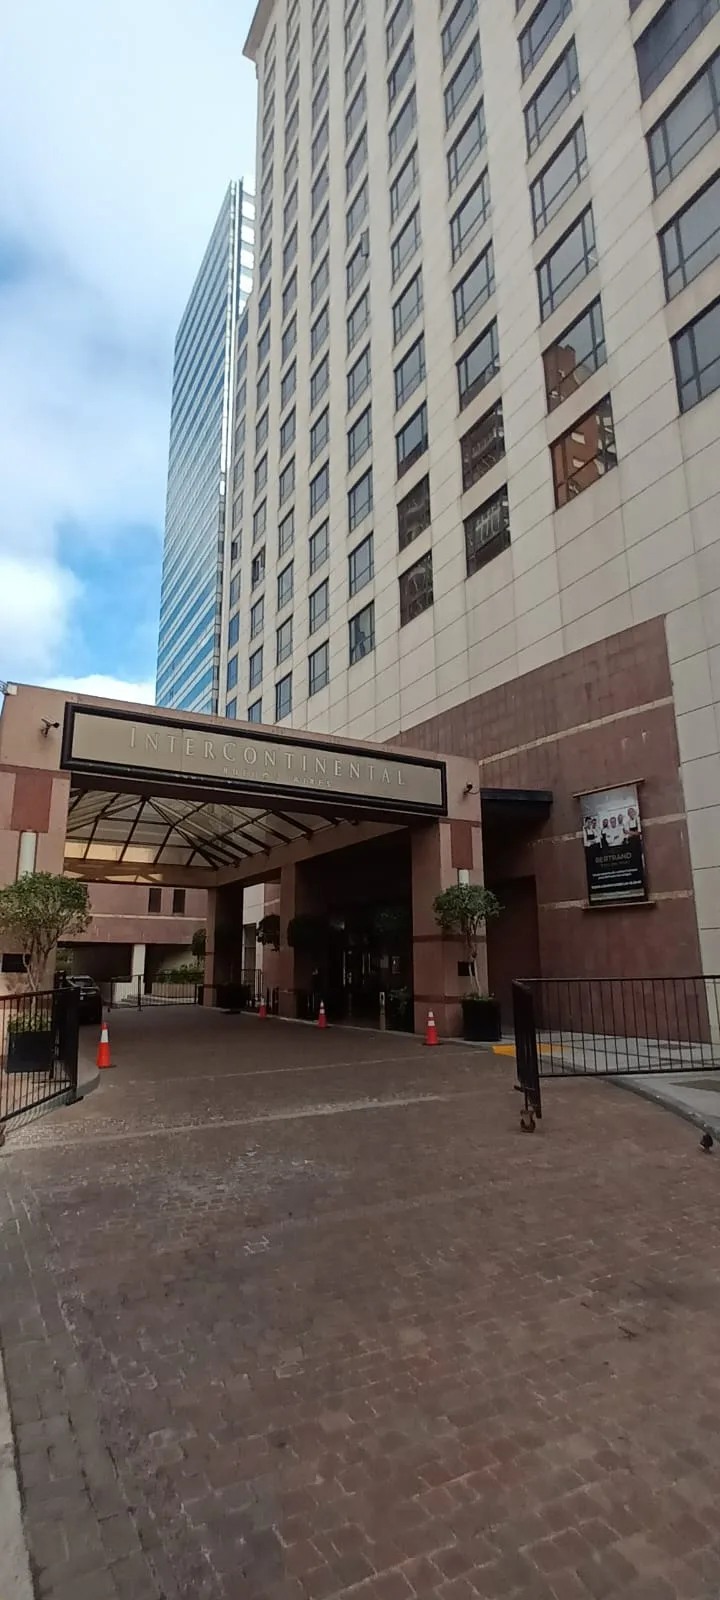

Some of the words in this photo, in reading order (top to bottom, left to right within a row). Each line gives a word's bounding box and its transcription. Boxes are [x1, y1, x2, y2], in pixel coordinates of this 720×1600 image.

[129, 726, 406, 785] INTERCONTINENTAL
[292, 775, 332, 788] AIRES
[595, 852, 632, 863] BERTRAND
